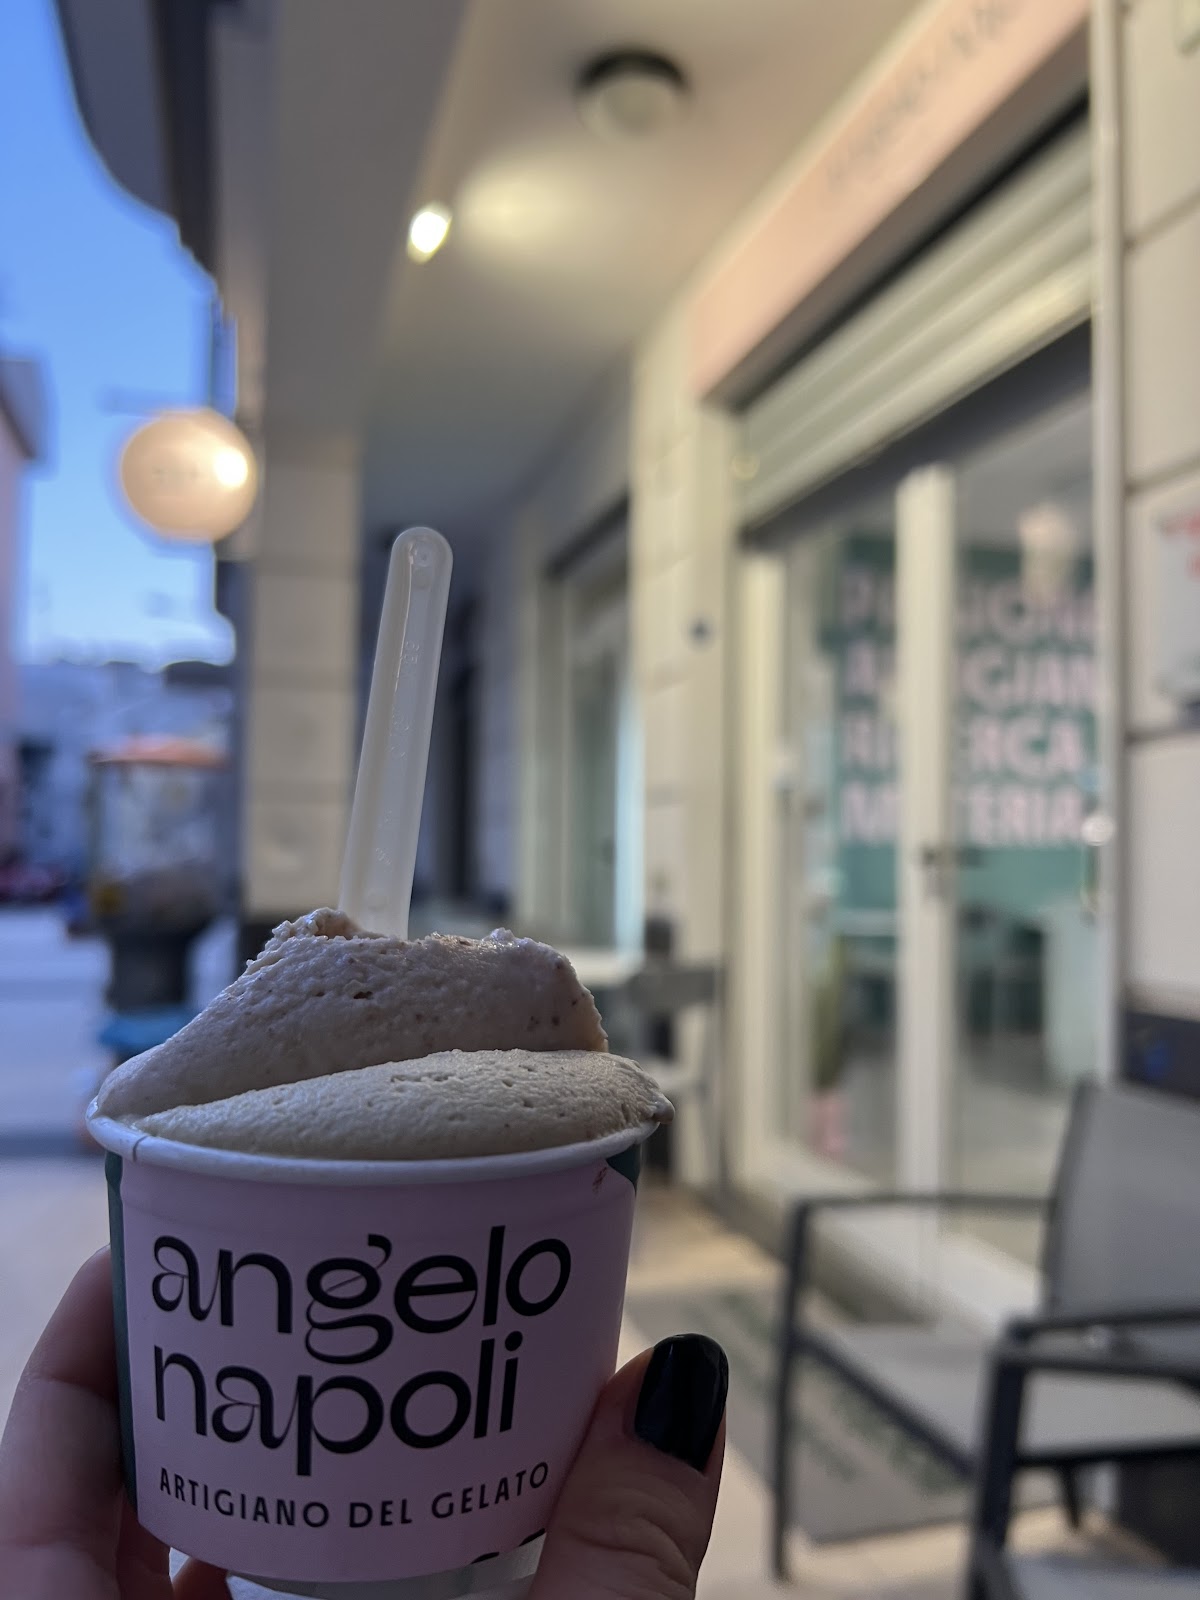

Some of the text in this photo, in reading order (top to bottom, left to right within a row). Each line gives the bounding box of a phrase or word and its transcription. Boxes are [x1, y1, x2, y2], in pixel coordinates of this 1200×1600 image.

[151, 1225, 572, 1365] angelo
[153, 1331, 524, 1477] napoli
[159, 1461, 550, 1529] ARTIGIANO DEL GELATO
